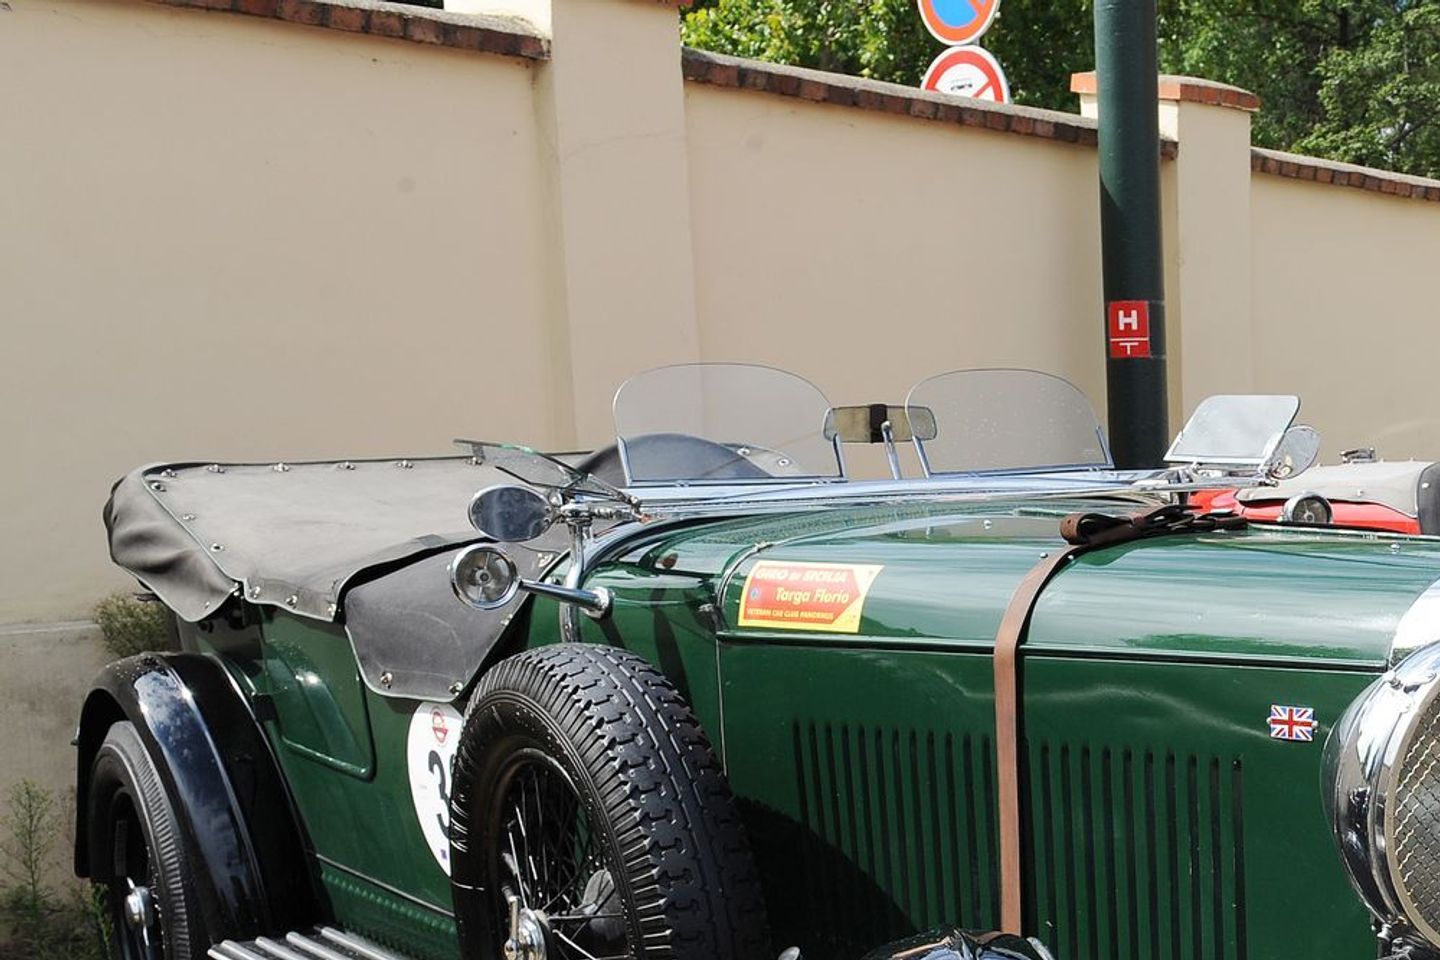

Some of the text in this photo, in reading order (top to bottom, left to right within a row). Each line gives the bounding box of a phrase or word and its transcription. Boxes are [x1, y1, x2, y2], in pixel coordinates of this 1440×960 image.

[1118, 309, 1138, 331] H
[776, 587, 850, 606] Targa Florio
